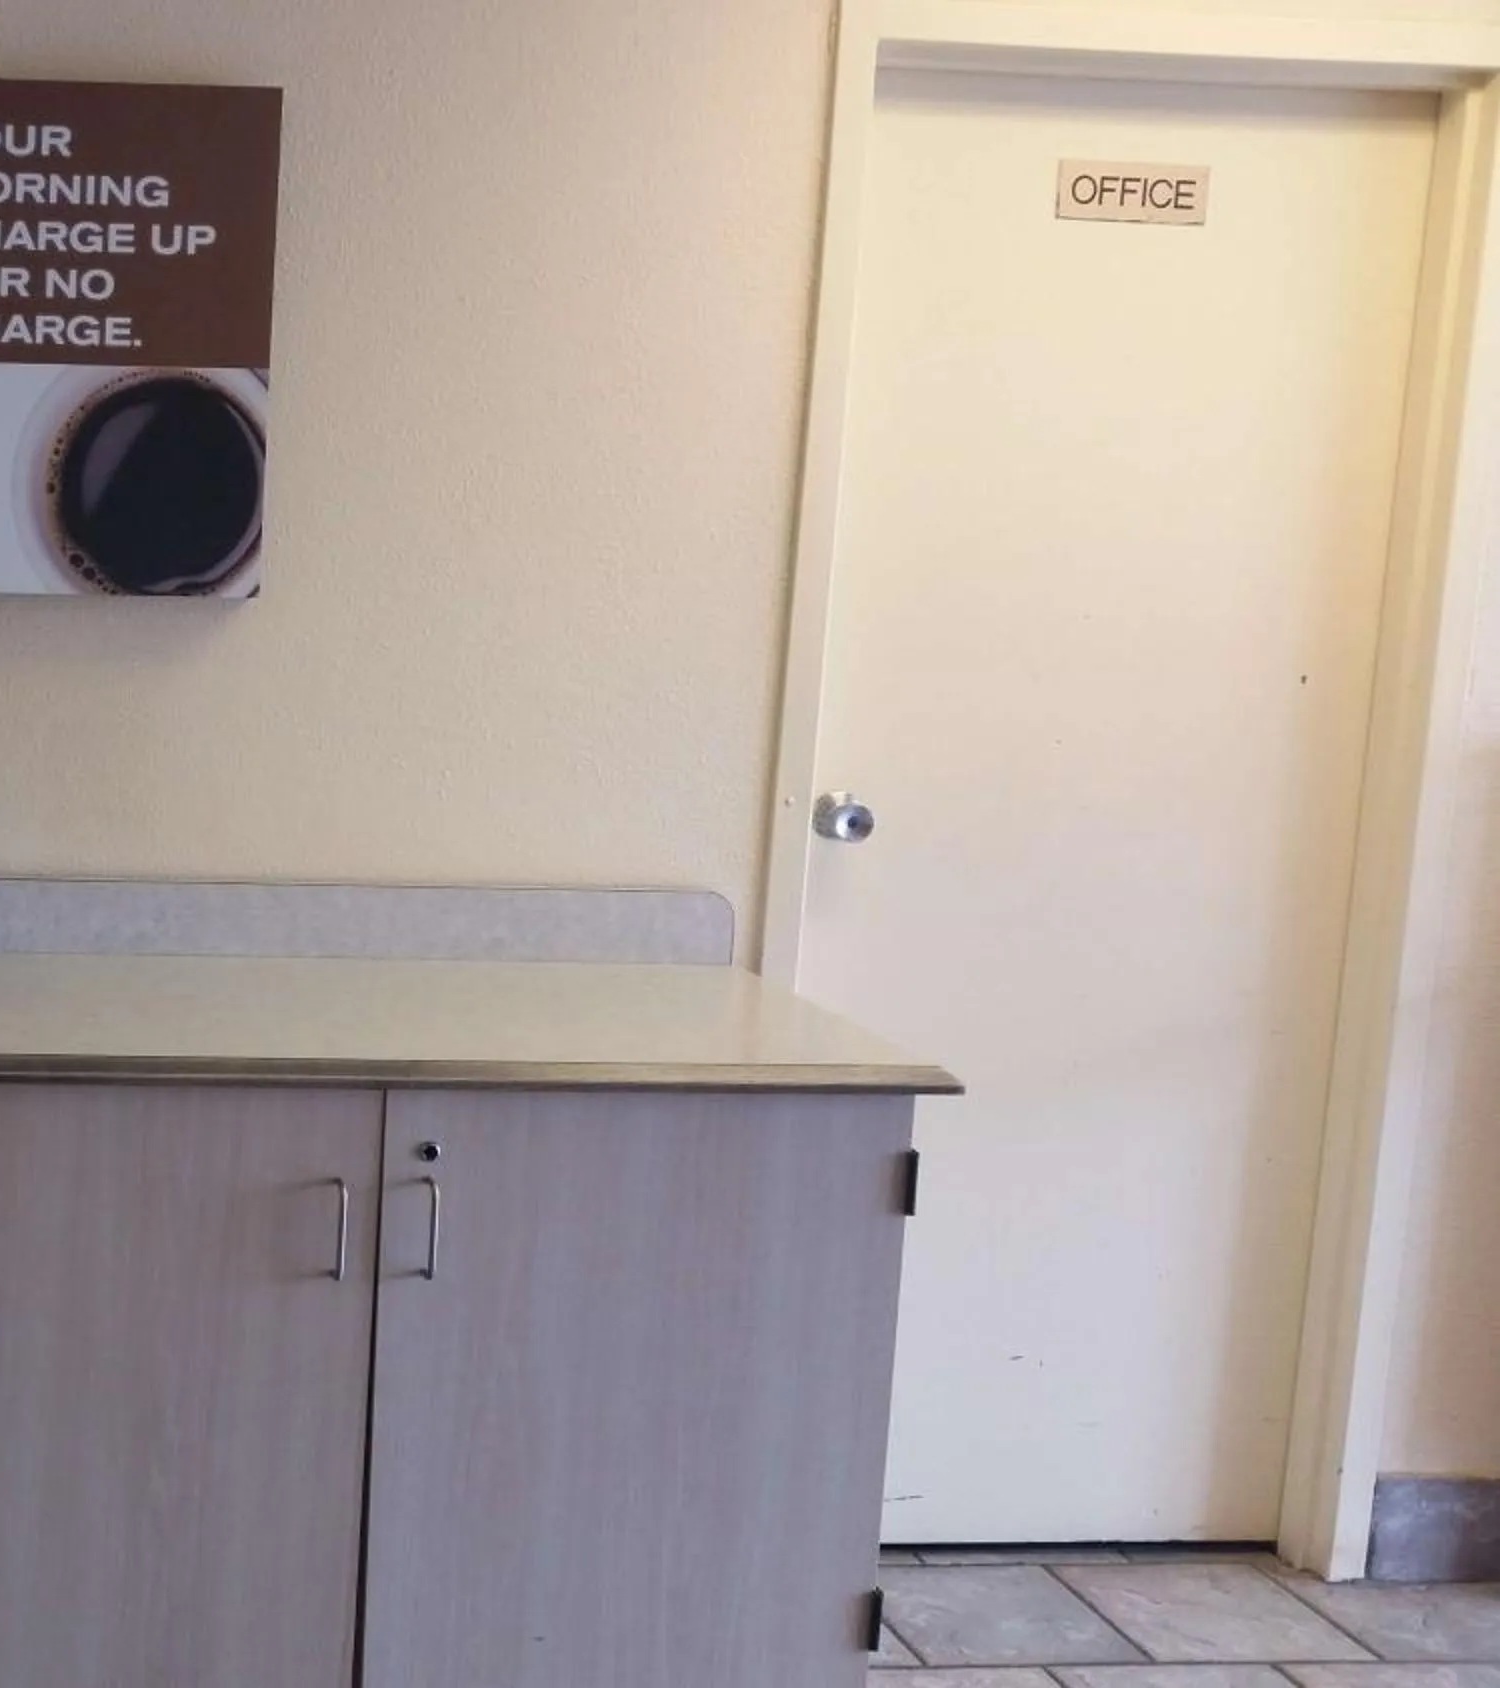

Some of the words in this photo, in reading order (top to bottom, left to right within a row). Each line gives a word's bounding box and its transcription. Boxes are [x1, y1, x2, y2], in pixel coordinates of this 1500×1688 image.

[1071, 174, 1197, 210] OFFICE
[151, 224, 218, 255] UP
[45, 269, 115, 301] NO
